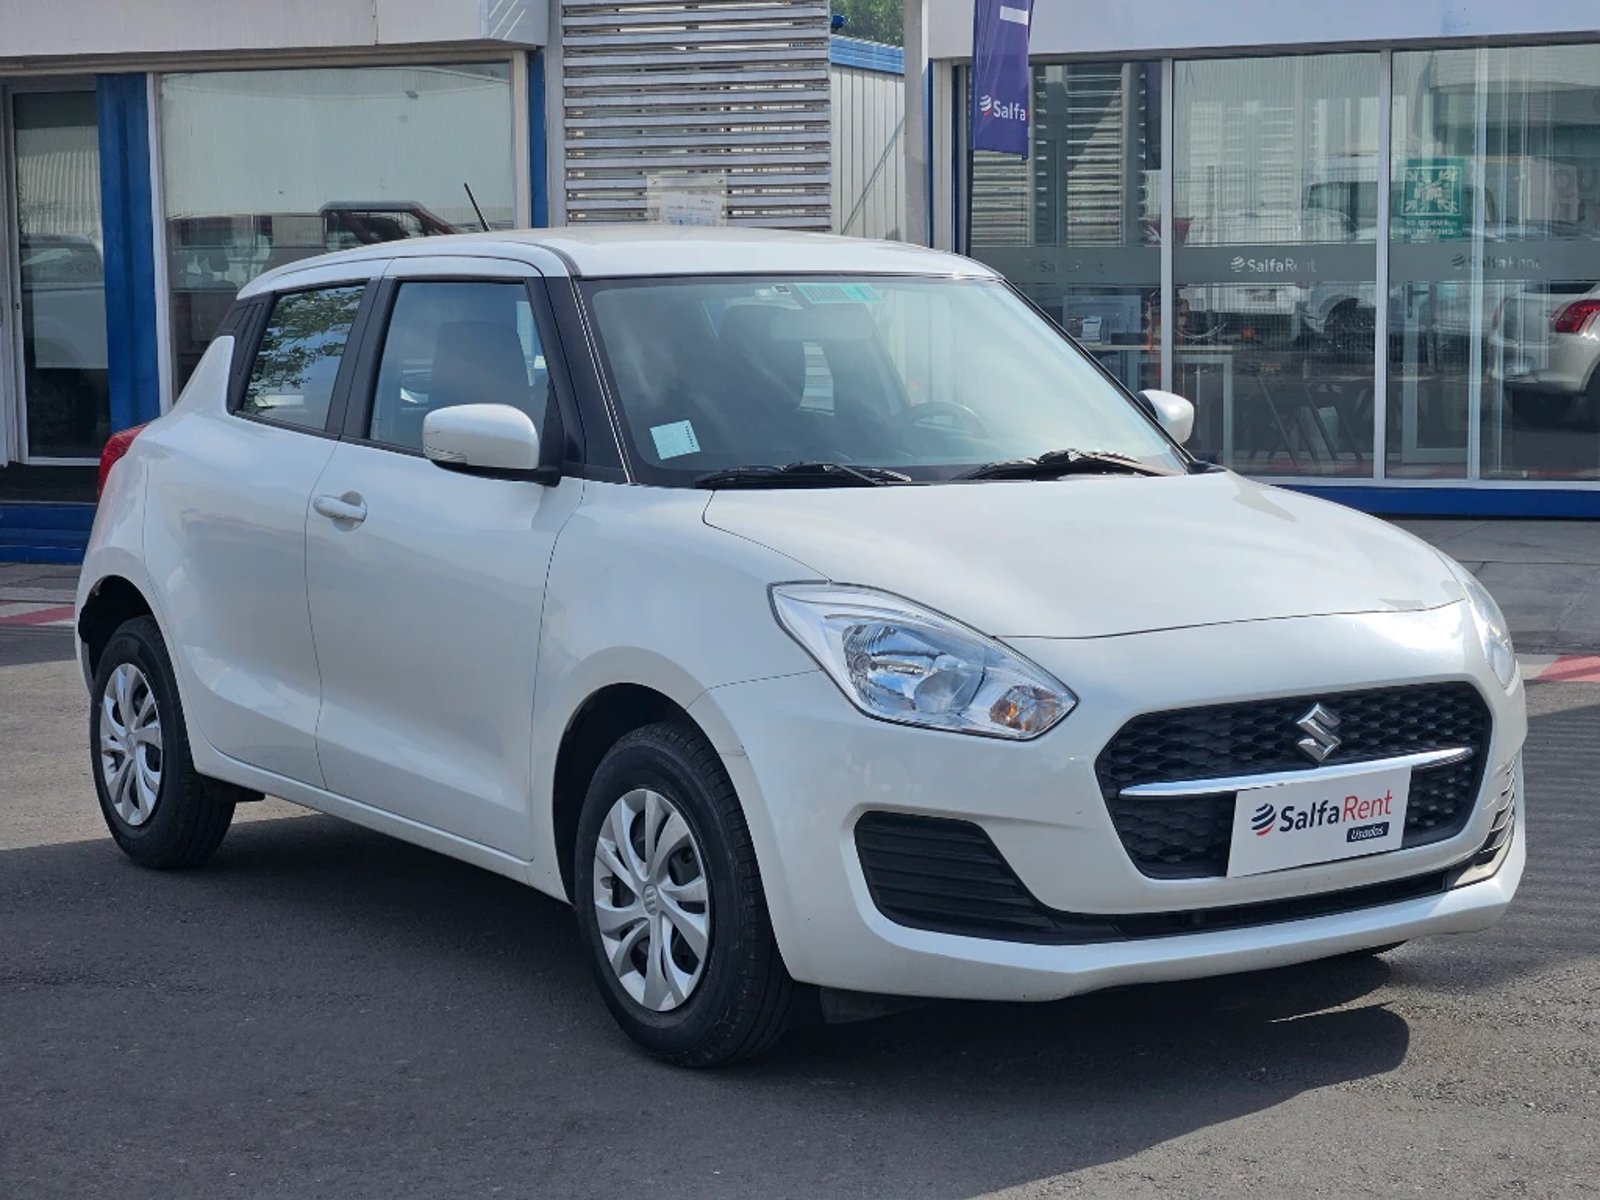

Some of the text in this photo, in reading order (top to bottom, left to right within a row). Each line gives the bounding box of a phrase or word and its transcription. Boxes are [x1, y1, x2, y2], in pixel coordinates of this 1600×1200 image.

[993, 100, 1026, 121] Salfa
[1247, 258, 1316, 273] SalfaRet
[1279, 788, 1393, 832] SalfaRent
[1351, 823, 1385, 841] Usados
